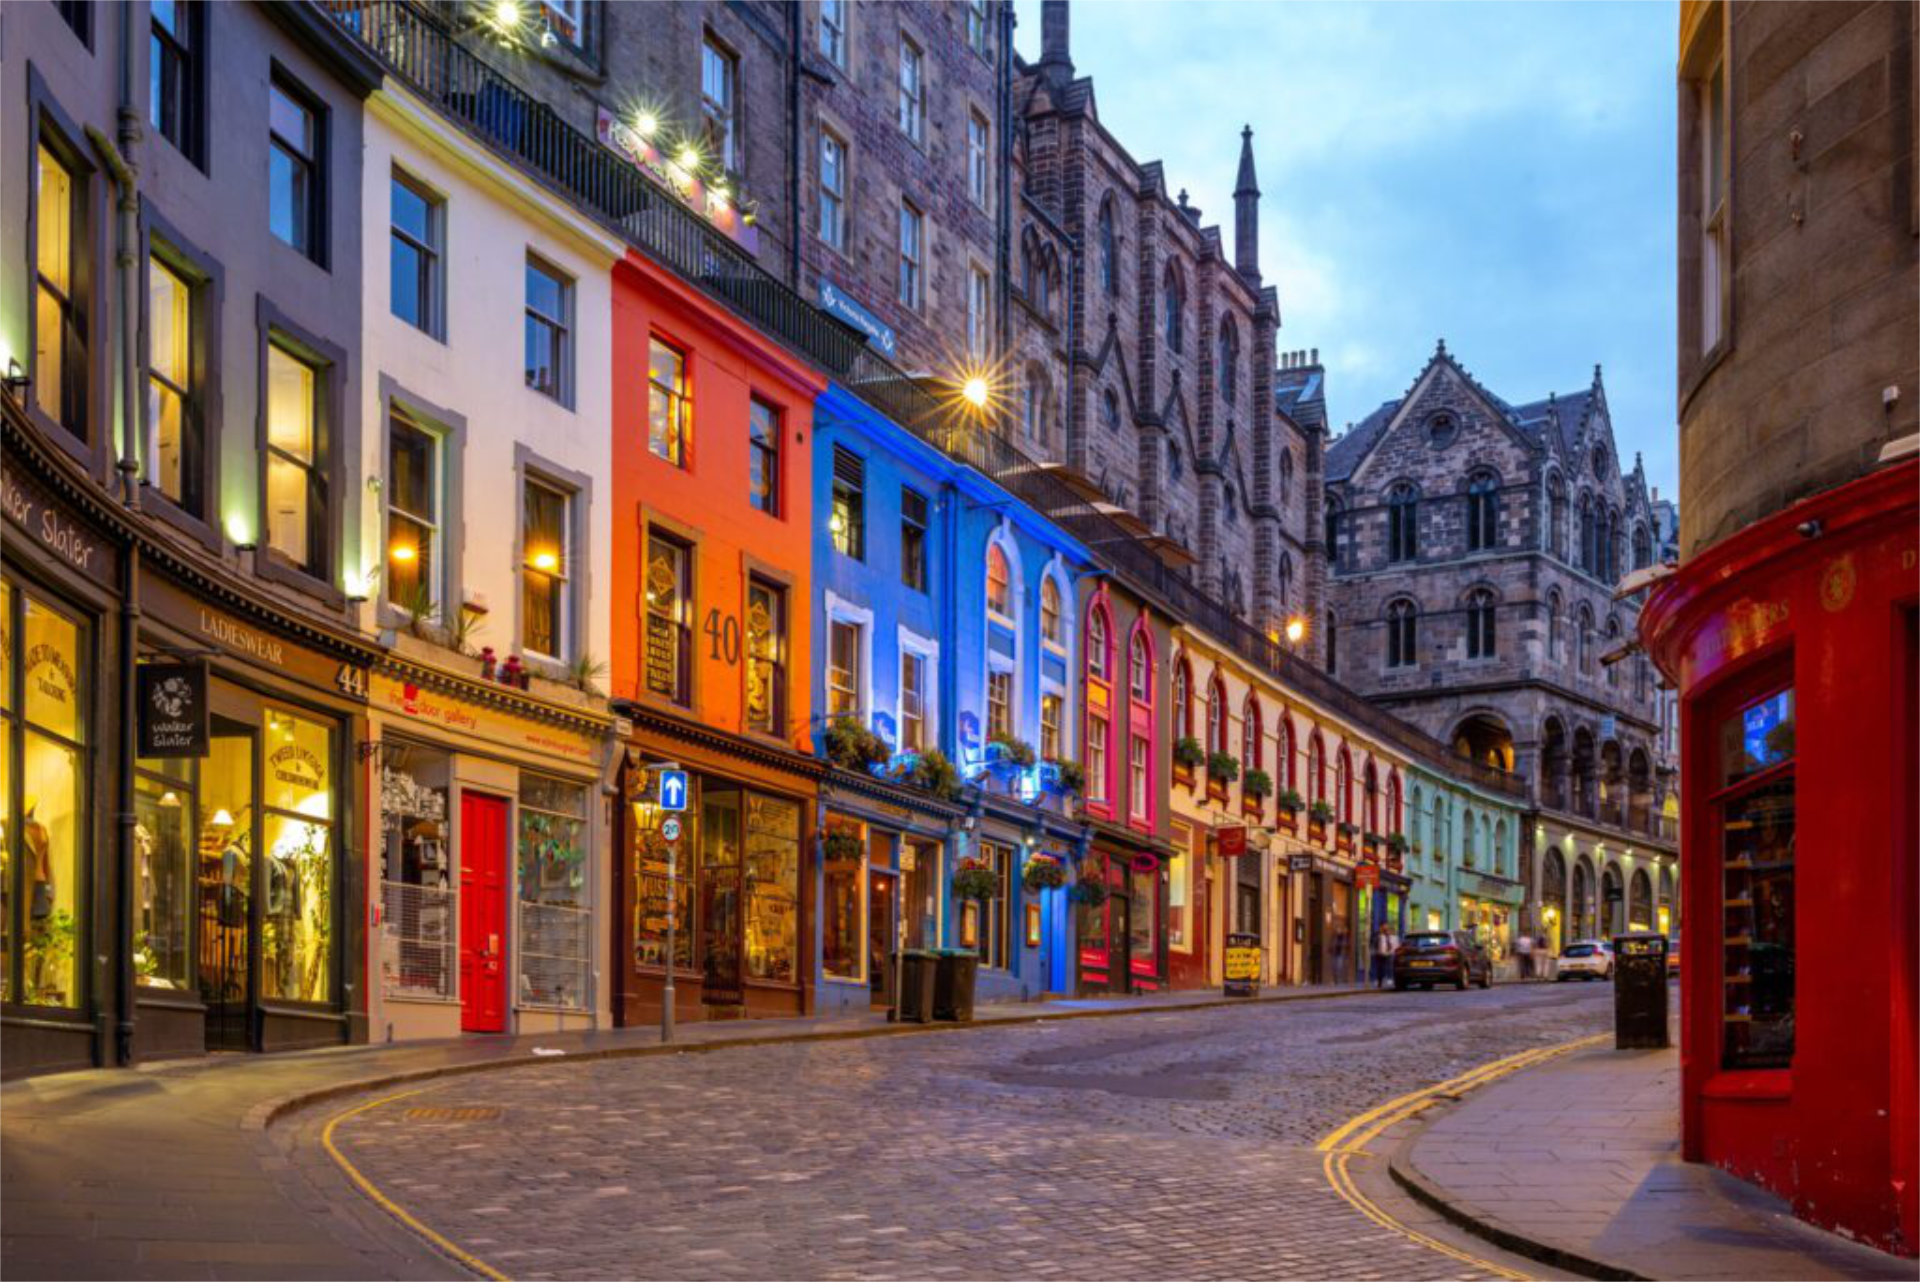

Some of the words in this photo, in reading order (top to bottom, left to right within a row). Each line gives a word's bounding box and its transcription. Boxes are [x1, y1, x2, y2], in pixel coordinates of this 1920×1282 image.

[42, 509, 93, 568] Slater
[200, 610, 283, 665] LADIESWEAR
[703, 608, 740, 667] 40
[152, 720, 194, 733] walker
[665, 823, 680, 836] 20
